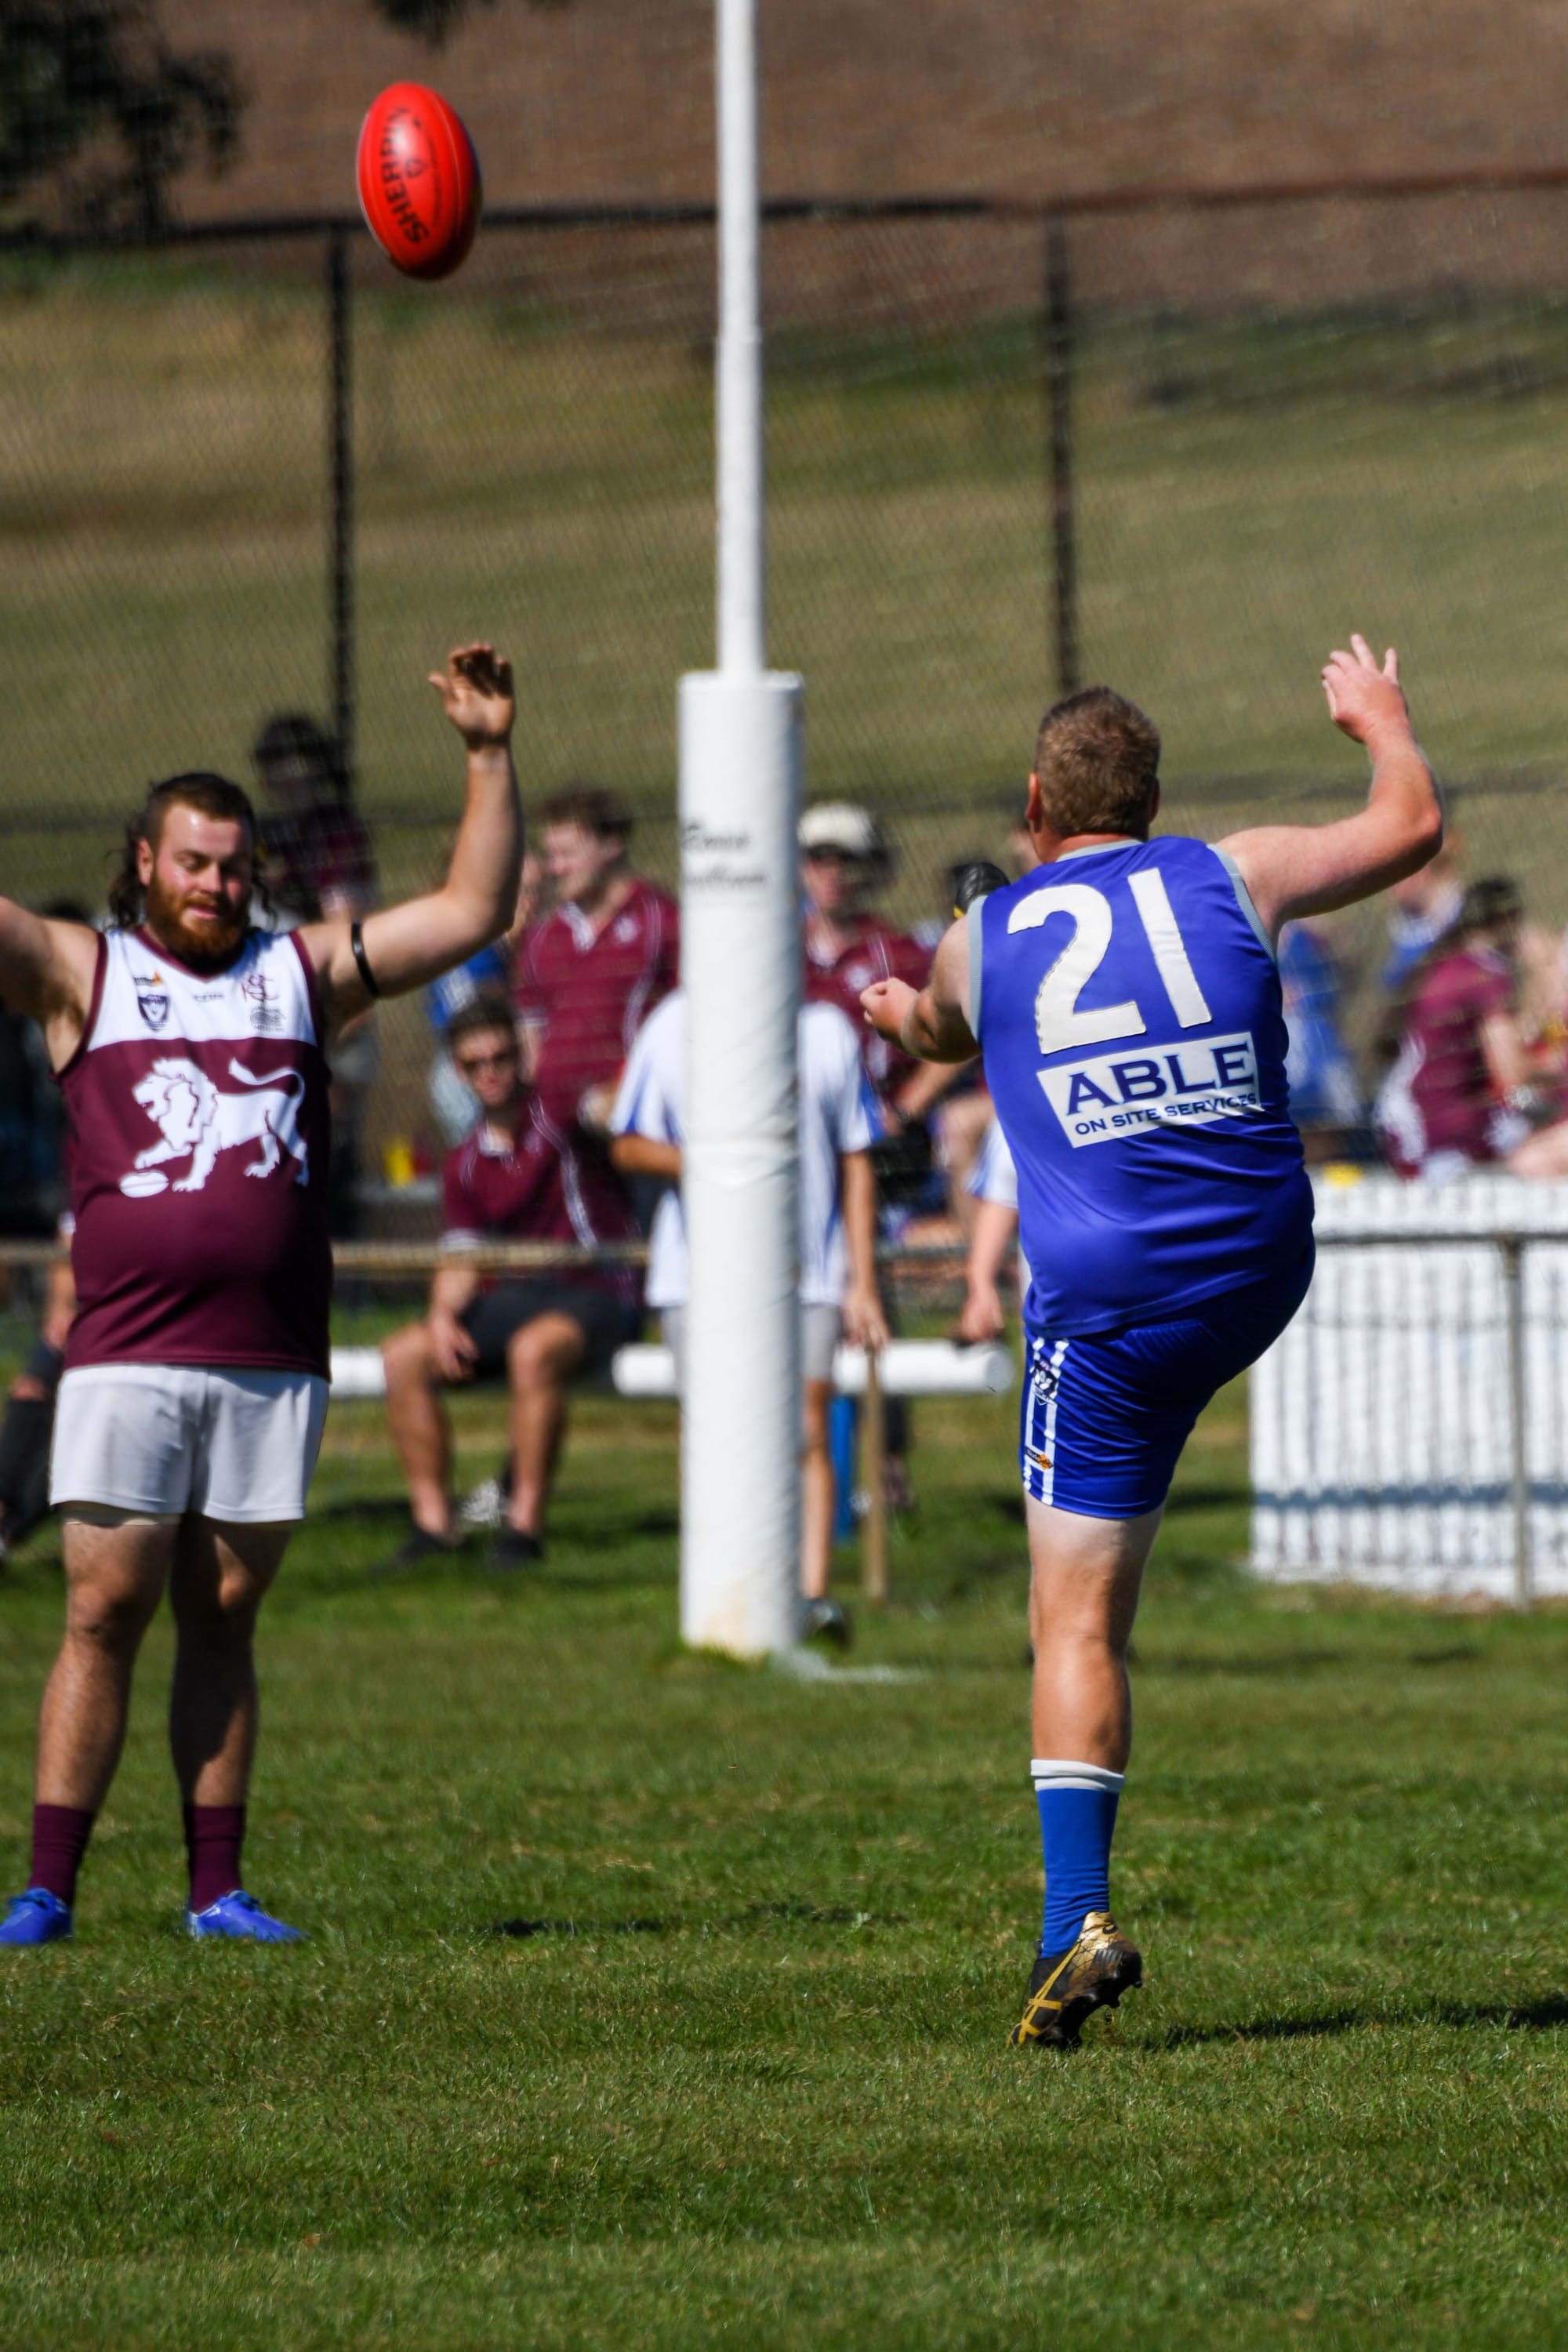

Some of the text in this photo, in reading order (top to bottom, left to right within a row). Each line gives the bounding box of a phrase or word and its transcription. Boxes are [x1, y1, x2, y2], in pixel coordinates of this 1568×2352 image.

[1007, 867, 1213, 1055] 21
[1066, 1041, 1255, 1116] ABLE
[1075, 1093, 1257, 1134] ON SITE SERVICES
